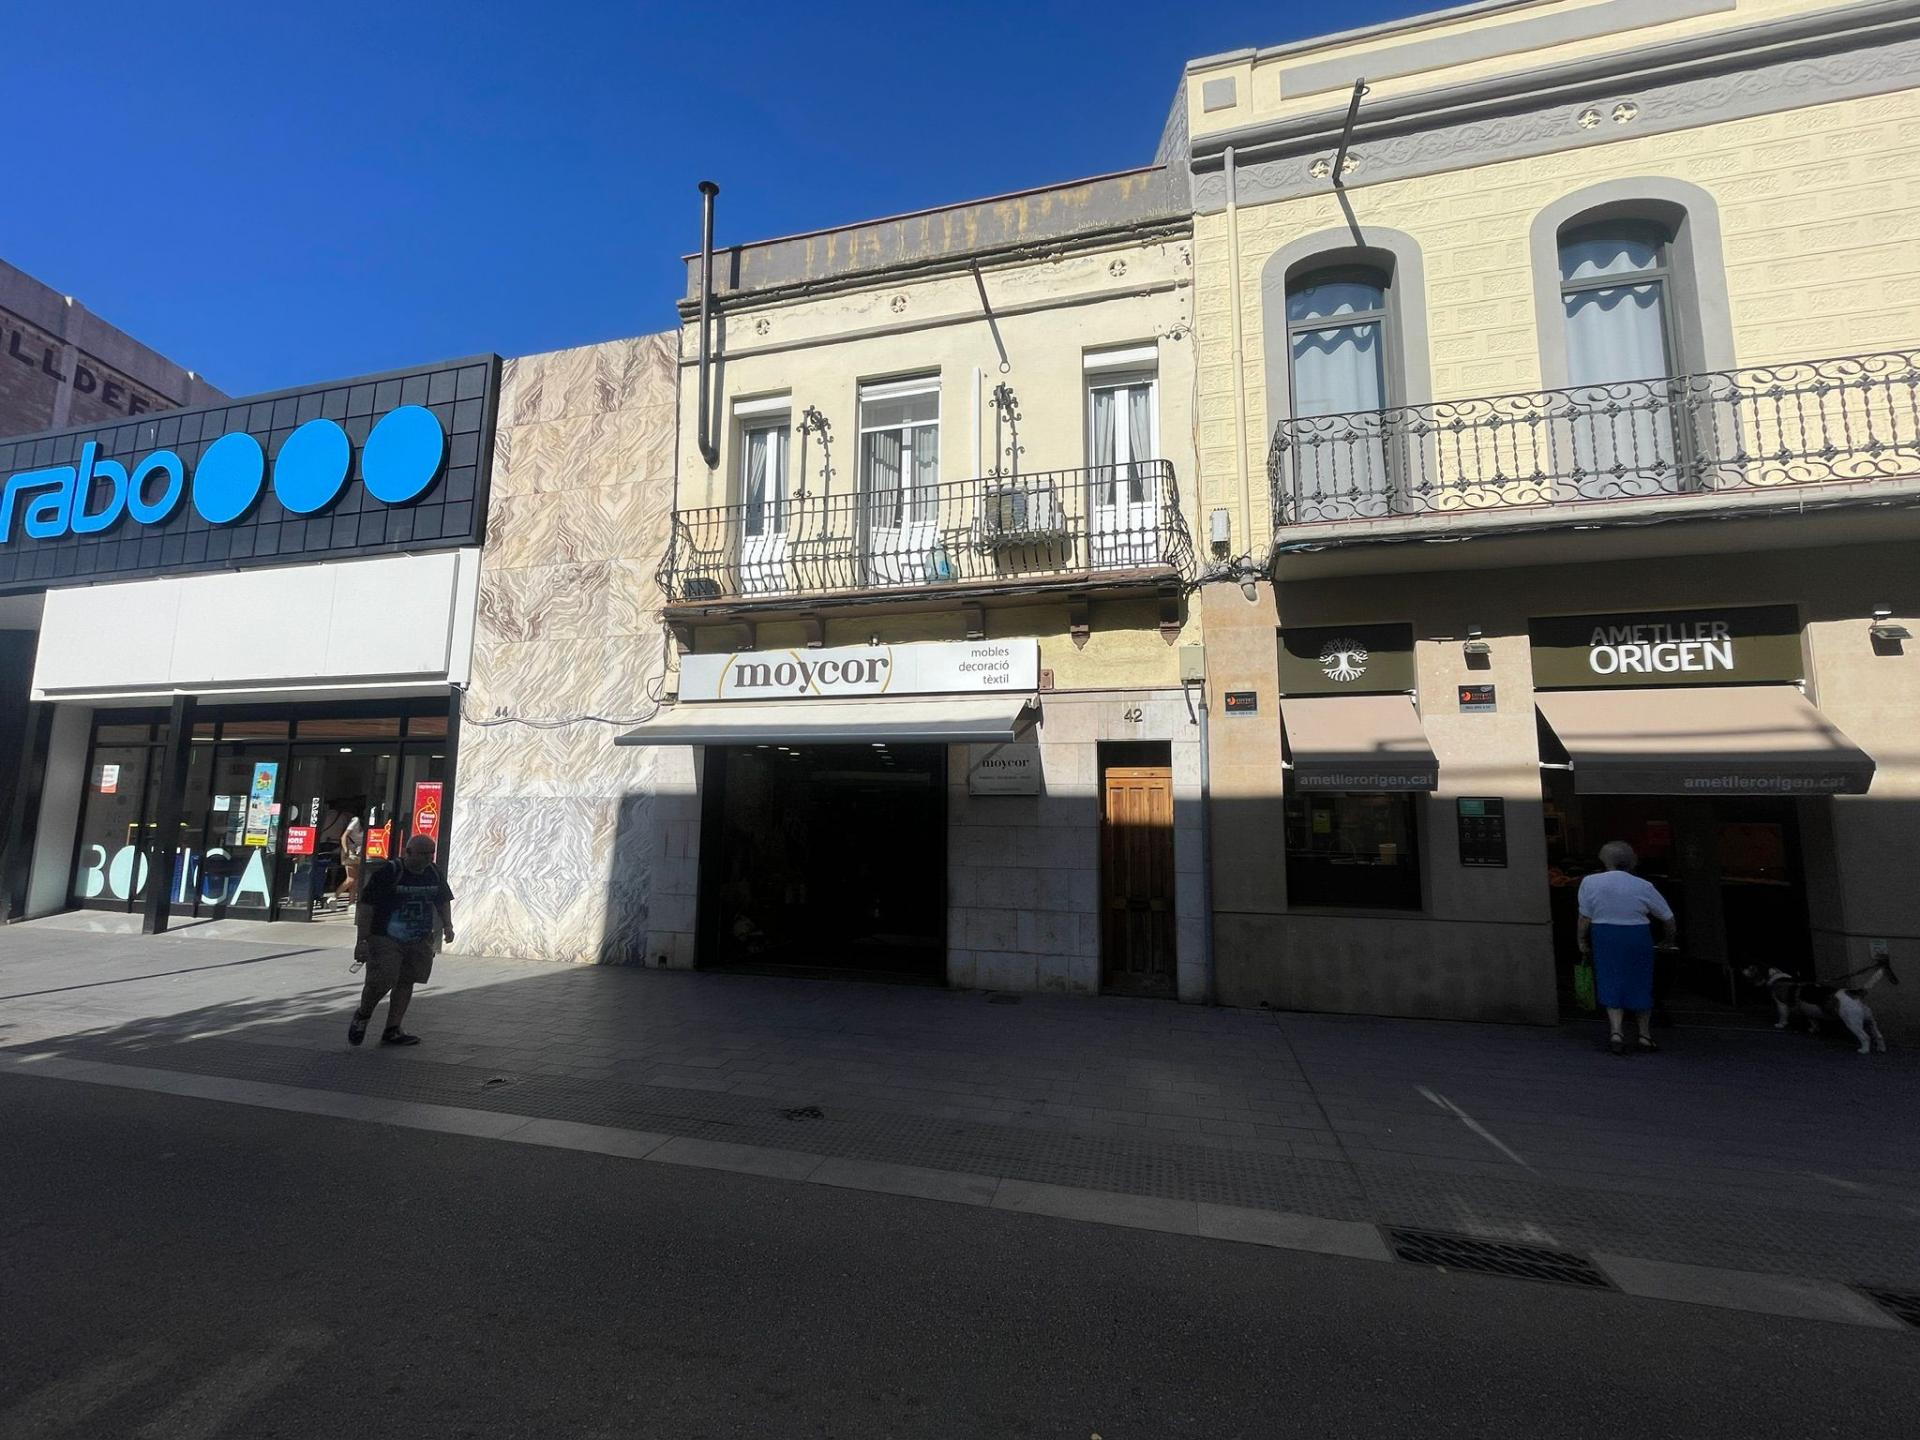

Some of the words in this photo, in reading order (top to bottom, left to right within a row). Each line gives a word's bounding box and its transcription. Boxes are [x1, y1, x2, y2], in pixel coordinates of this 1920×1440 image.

[0, 441, 184, 543] rabo
[1589, 620, 1732, 647] AMETLLER
[971, 647, 1010, 657] mobles
[1589, 641, 1735, 675] ORIGEN
[958, 660, 1010, 672] decoració
[734, 657, 889, 694] moycor
[983, 674, 1010, 685] tèxtil
[1123, 708, 1144, 723] 42
[982, 759, 1030, 770] moycor
[1299, 773, 1434, 787] ametllerorigen.cat
[1683, 775, 1847, 791] ametllerorigen.cat
[86, 844, 271, 908] BOIGA
